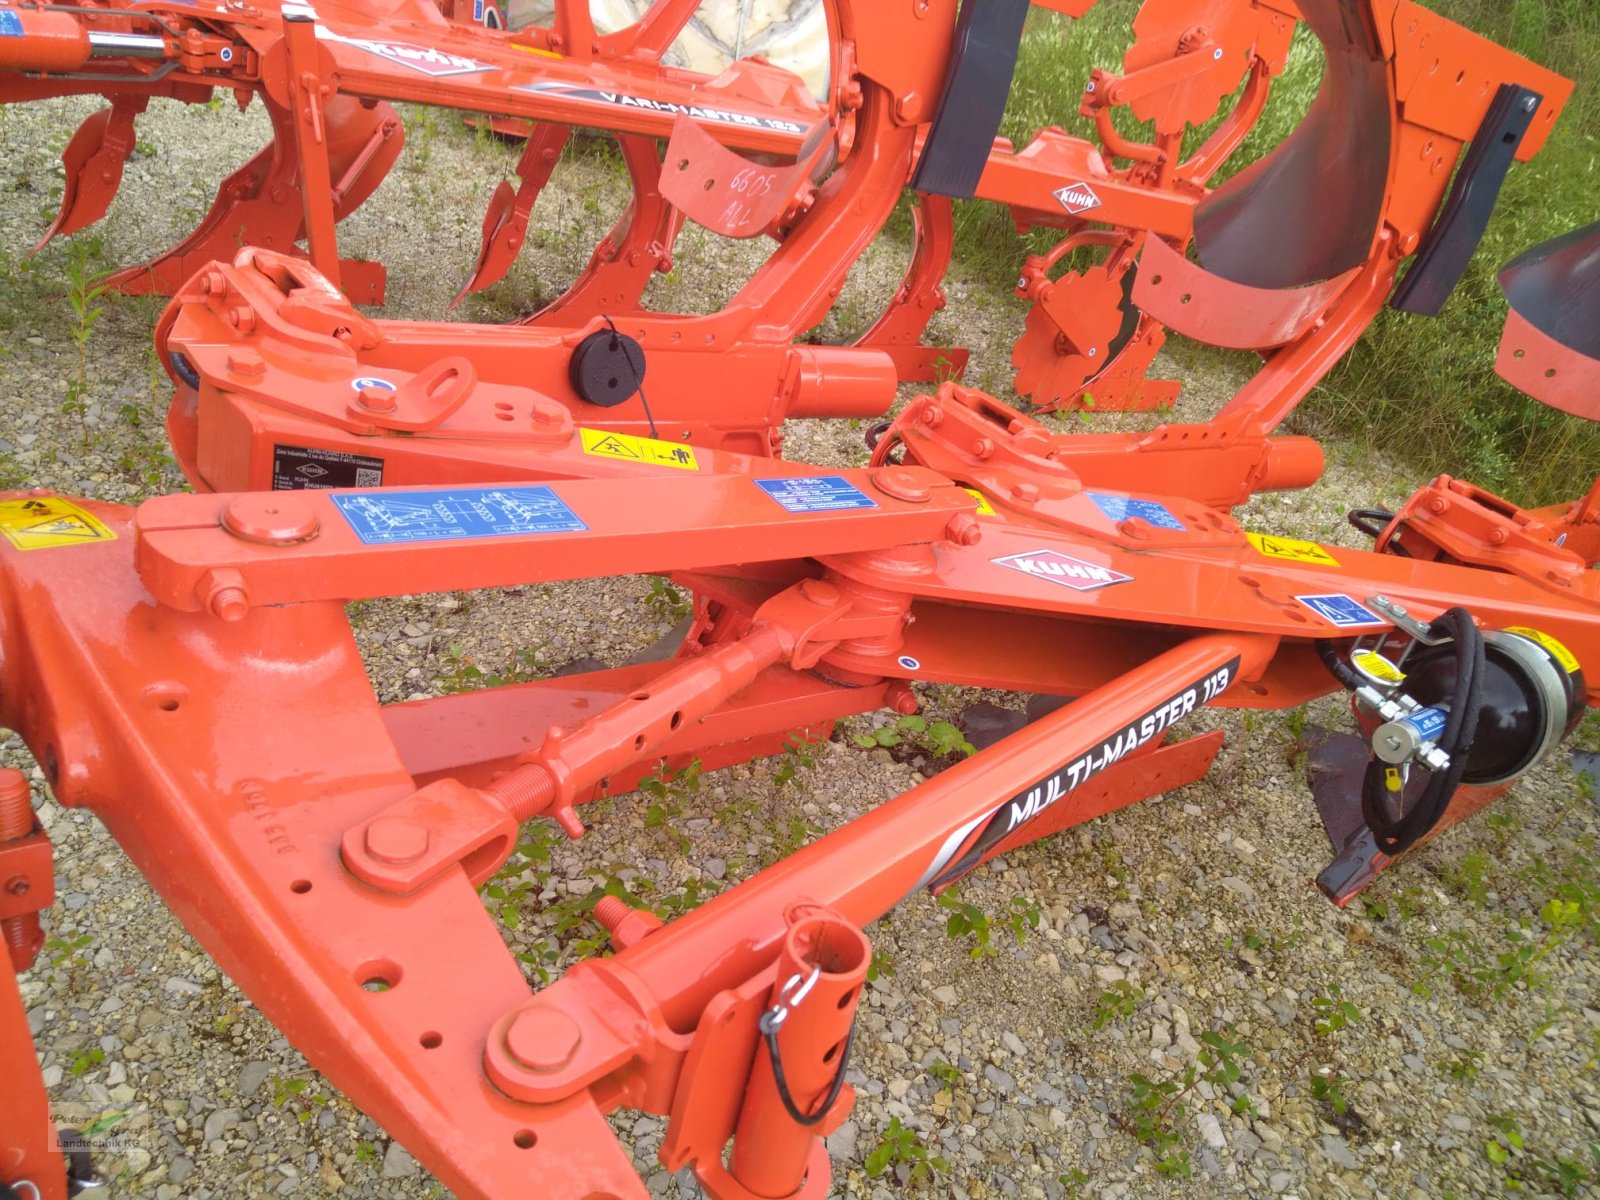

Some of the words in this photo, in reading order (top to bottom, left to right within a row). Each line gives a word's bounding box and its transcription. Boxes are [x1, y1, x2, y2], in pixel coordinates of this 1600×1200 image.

[367, 42, 477, 70] KUHN
[599, 91, 762, 126] VARI-MASTER
[730, 168, 777, 197] 6605
[1060, 190, 1095, 208] KUHN
[1013, 558, 1114, 582] KUHN
[1006, 688, 1197, 832] MULTI-MASTER
[1202, 667, 1230, 703] 113
